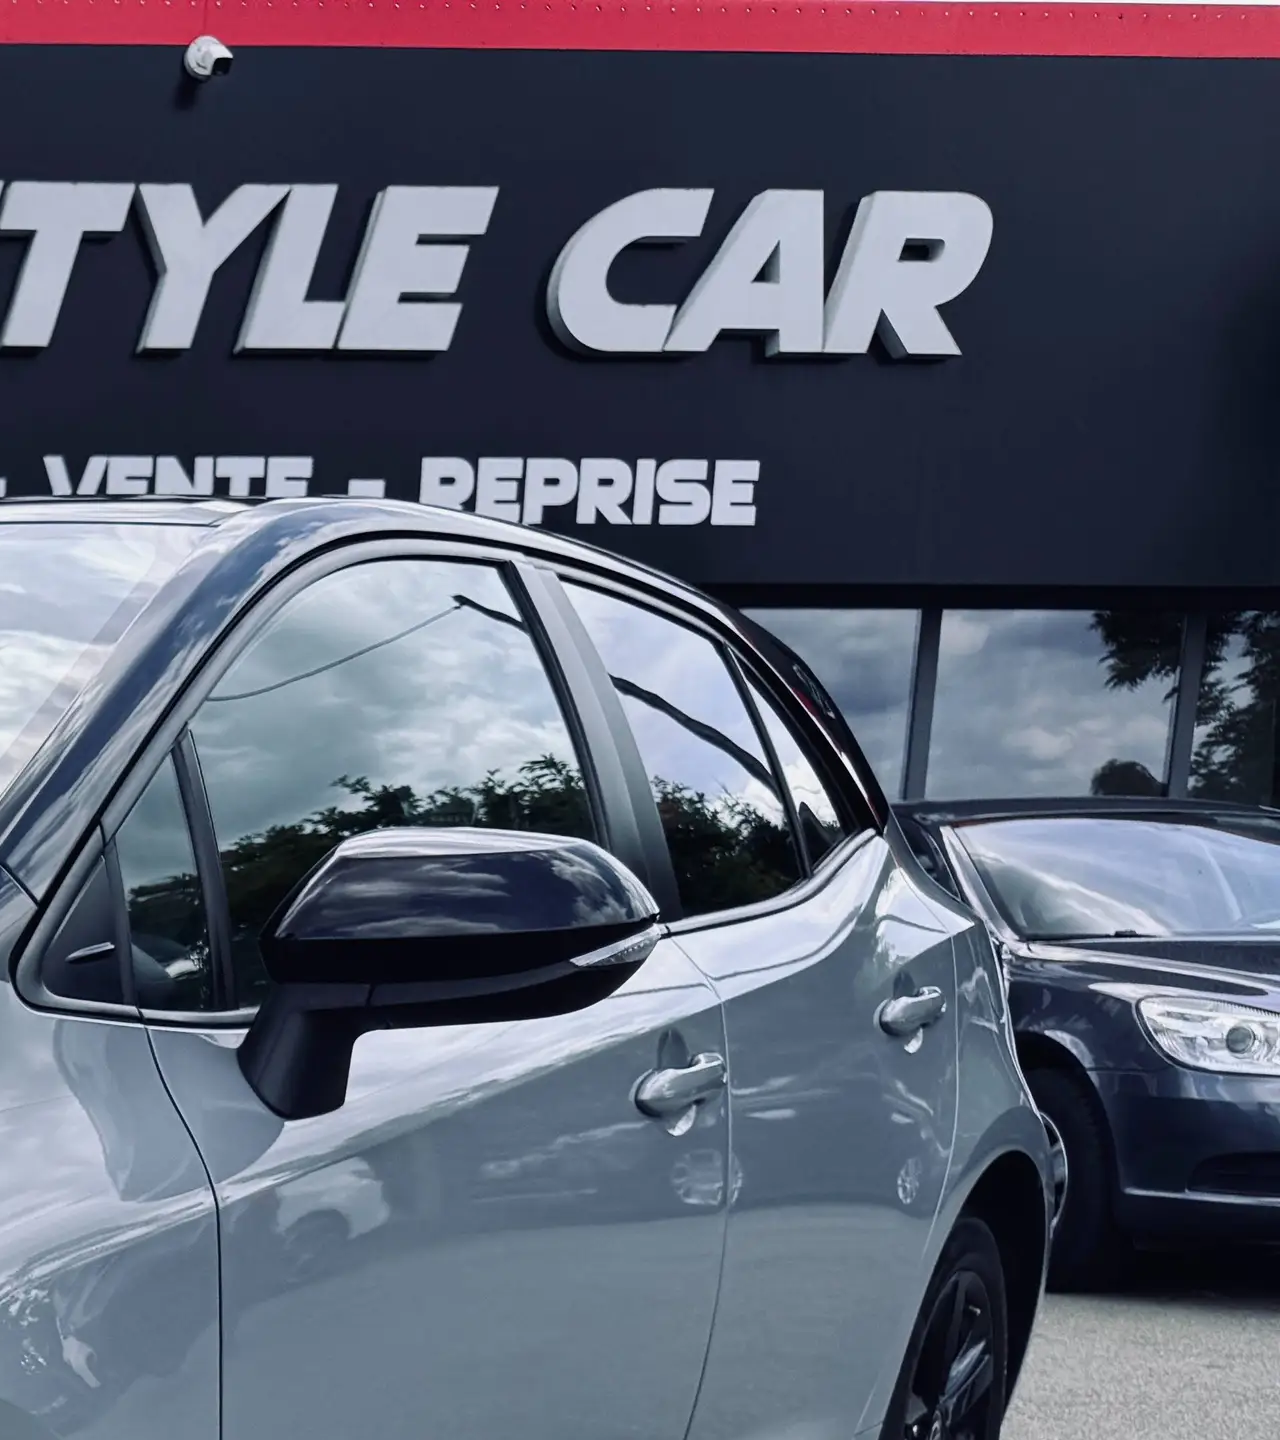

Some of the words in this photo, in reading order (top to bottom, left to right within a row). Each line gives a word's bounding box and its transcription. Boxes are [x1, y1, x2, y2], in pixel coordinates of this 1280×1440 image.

[548, 187, 995, 358] CAR
[42, 454, 315, 499] VENTE
[419, 456, 761, 526] REPRISE
